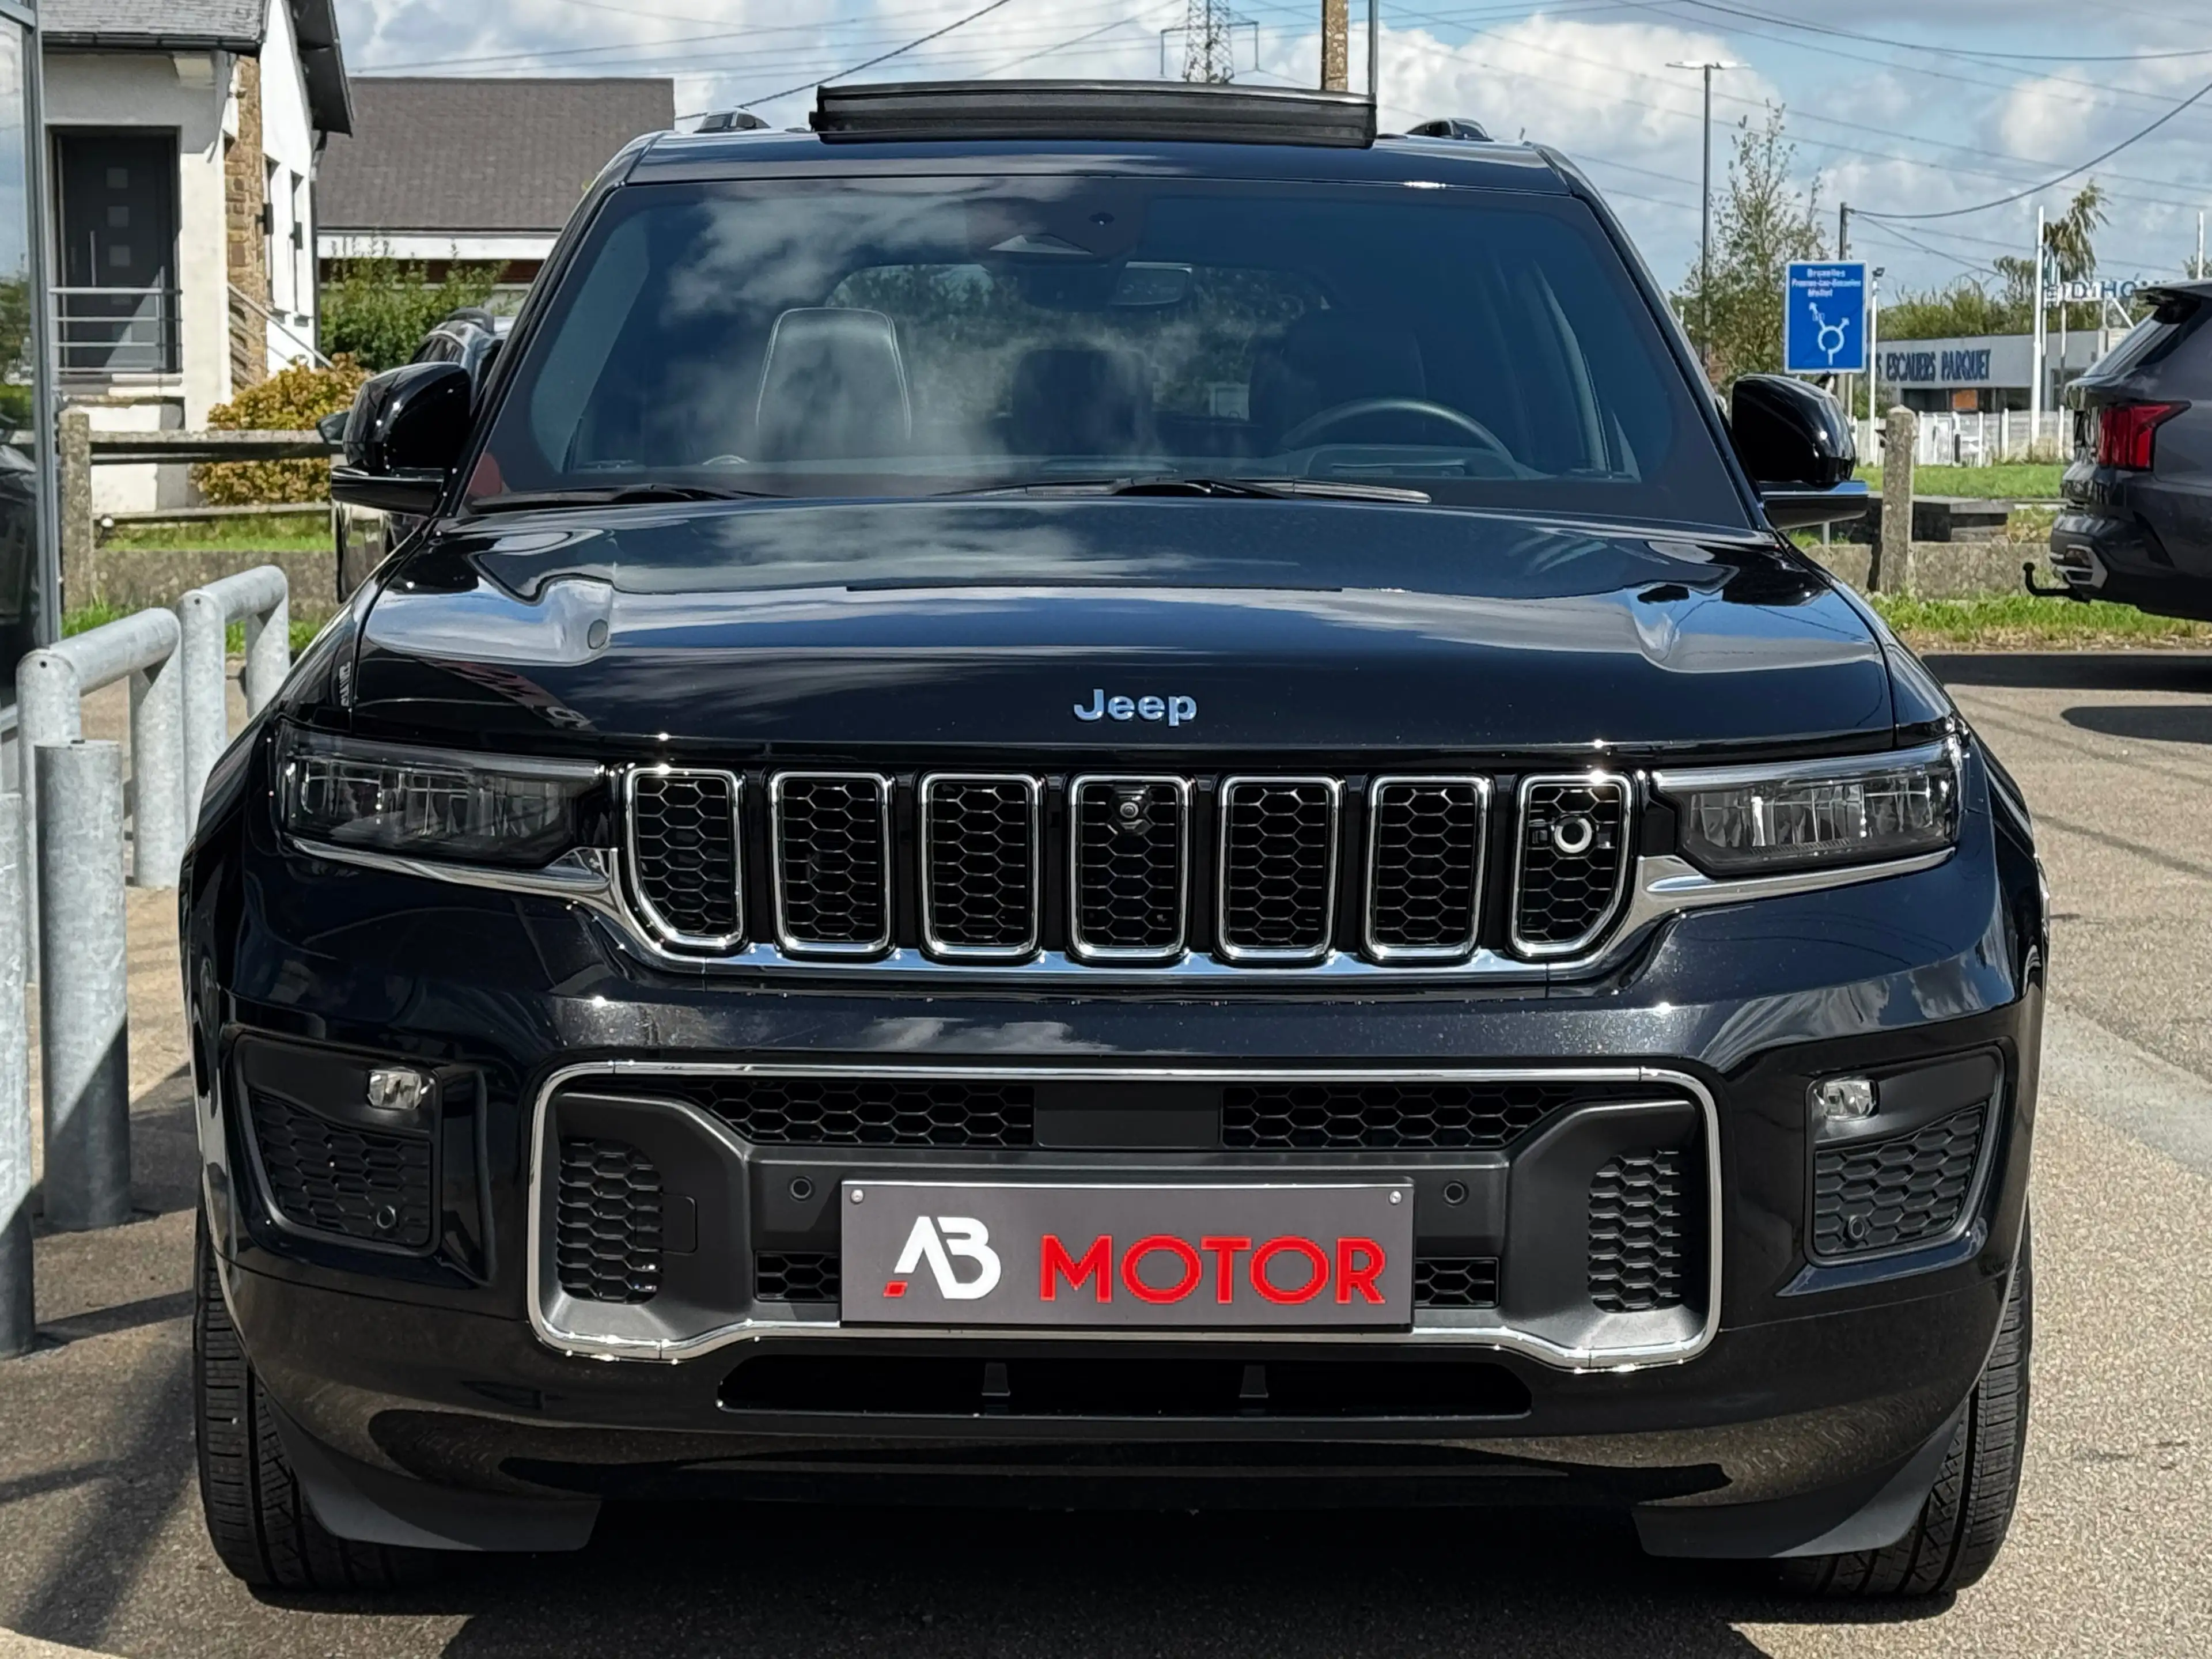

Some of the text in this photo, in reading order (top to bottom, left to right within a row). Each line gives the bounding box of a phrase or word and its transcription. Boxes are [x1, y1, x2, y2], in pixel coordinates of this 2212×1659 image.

[1886, 351, 1936, 382] ESCALIERS
[1941, 349, 1991, 381] PARQUET
[1074, 689, 1197, 726] Jeep
[883, 1215, 1386, 1305] AB MOTOR
